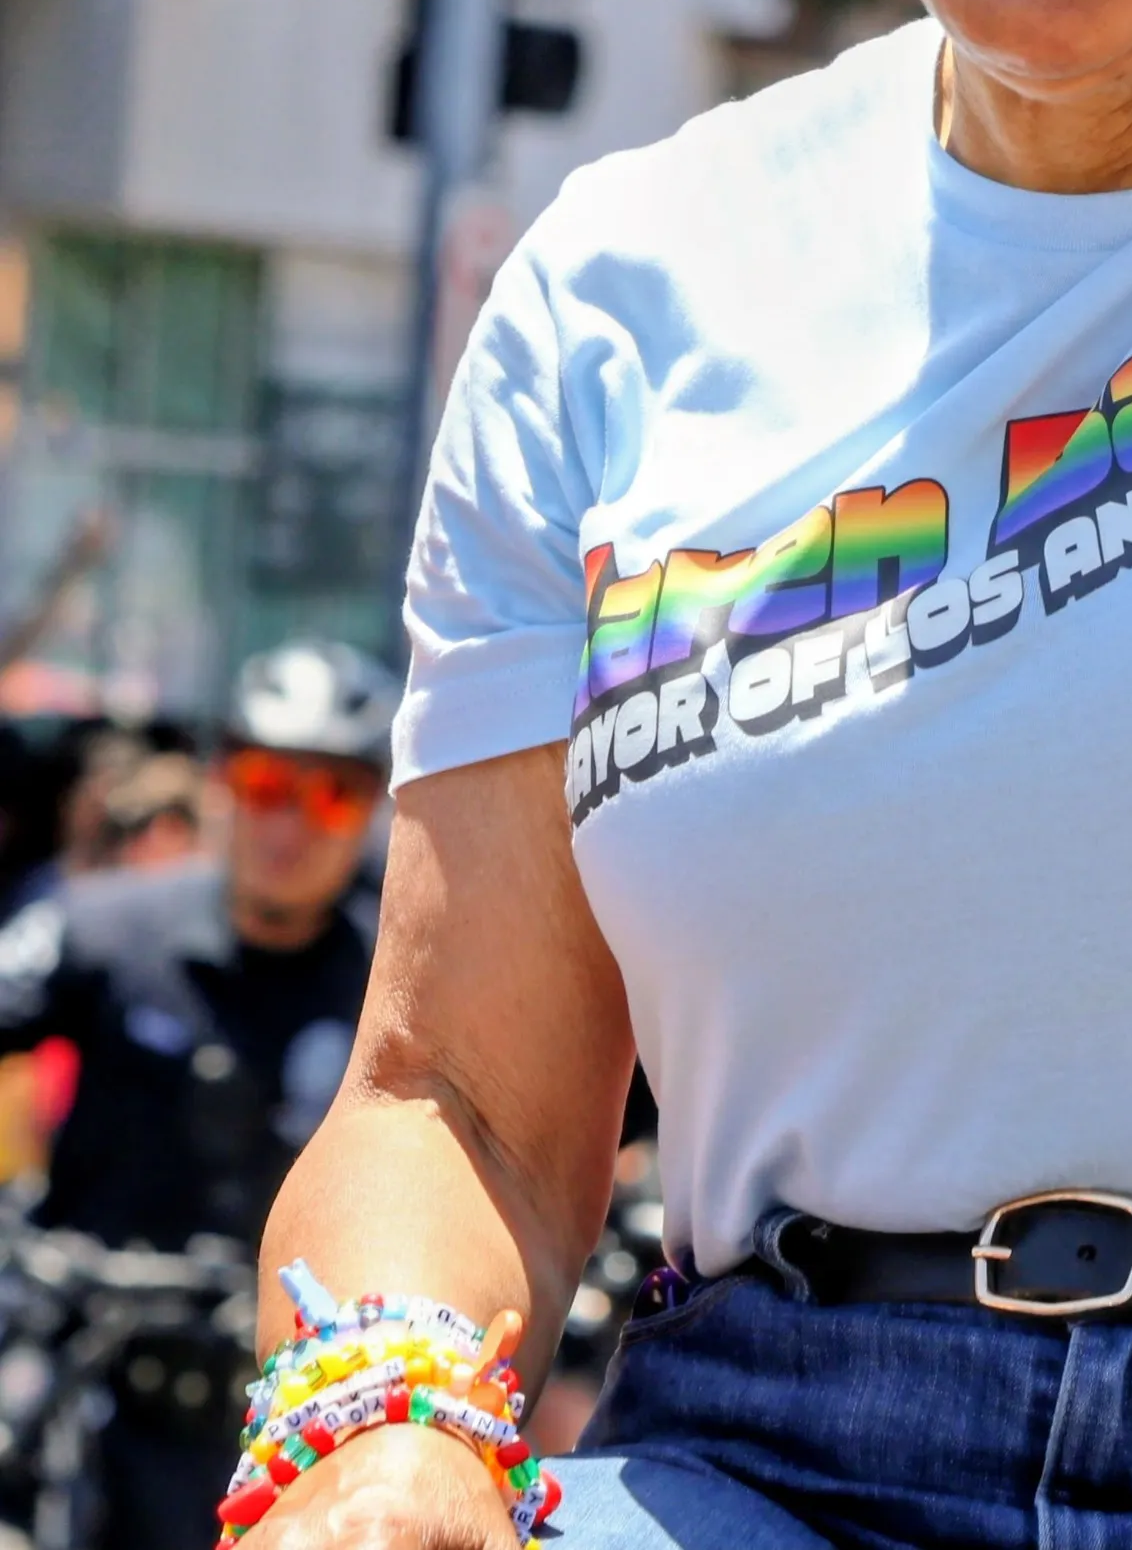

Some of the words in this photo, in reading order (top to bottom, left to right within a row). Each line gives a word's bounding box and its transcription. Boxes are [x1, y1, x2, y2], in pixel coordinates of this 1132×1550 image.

[566, 671, 712, 820] AYOR
[728, 630, 846, 724] OF
[864, 549, 1025, 679] LOS
